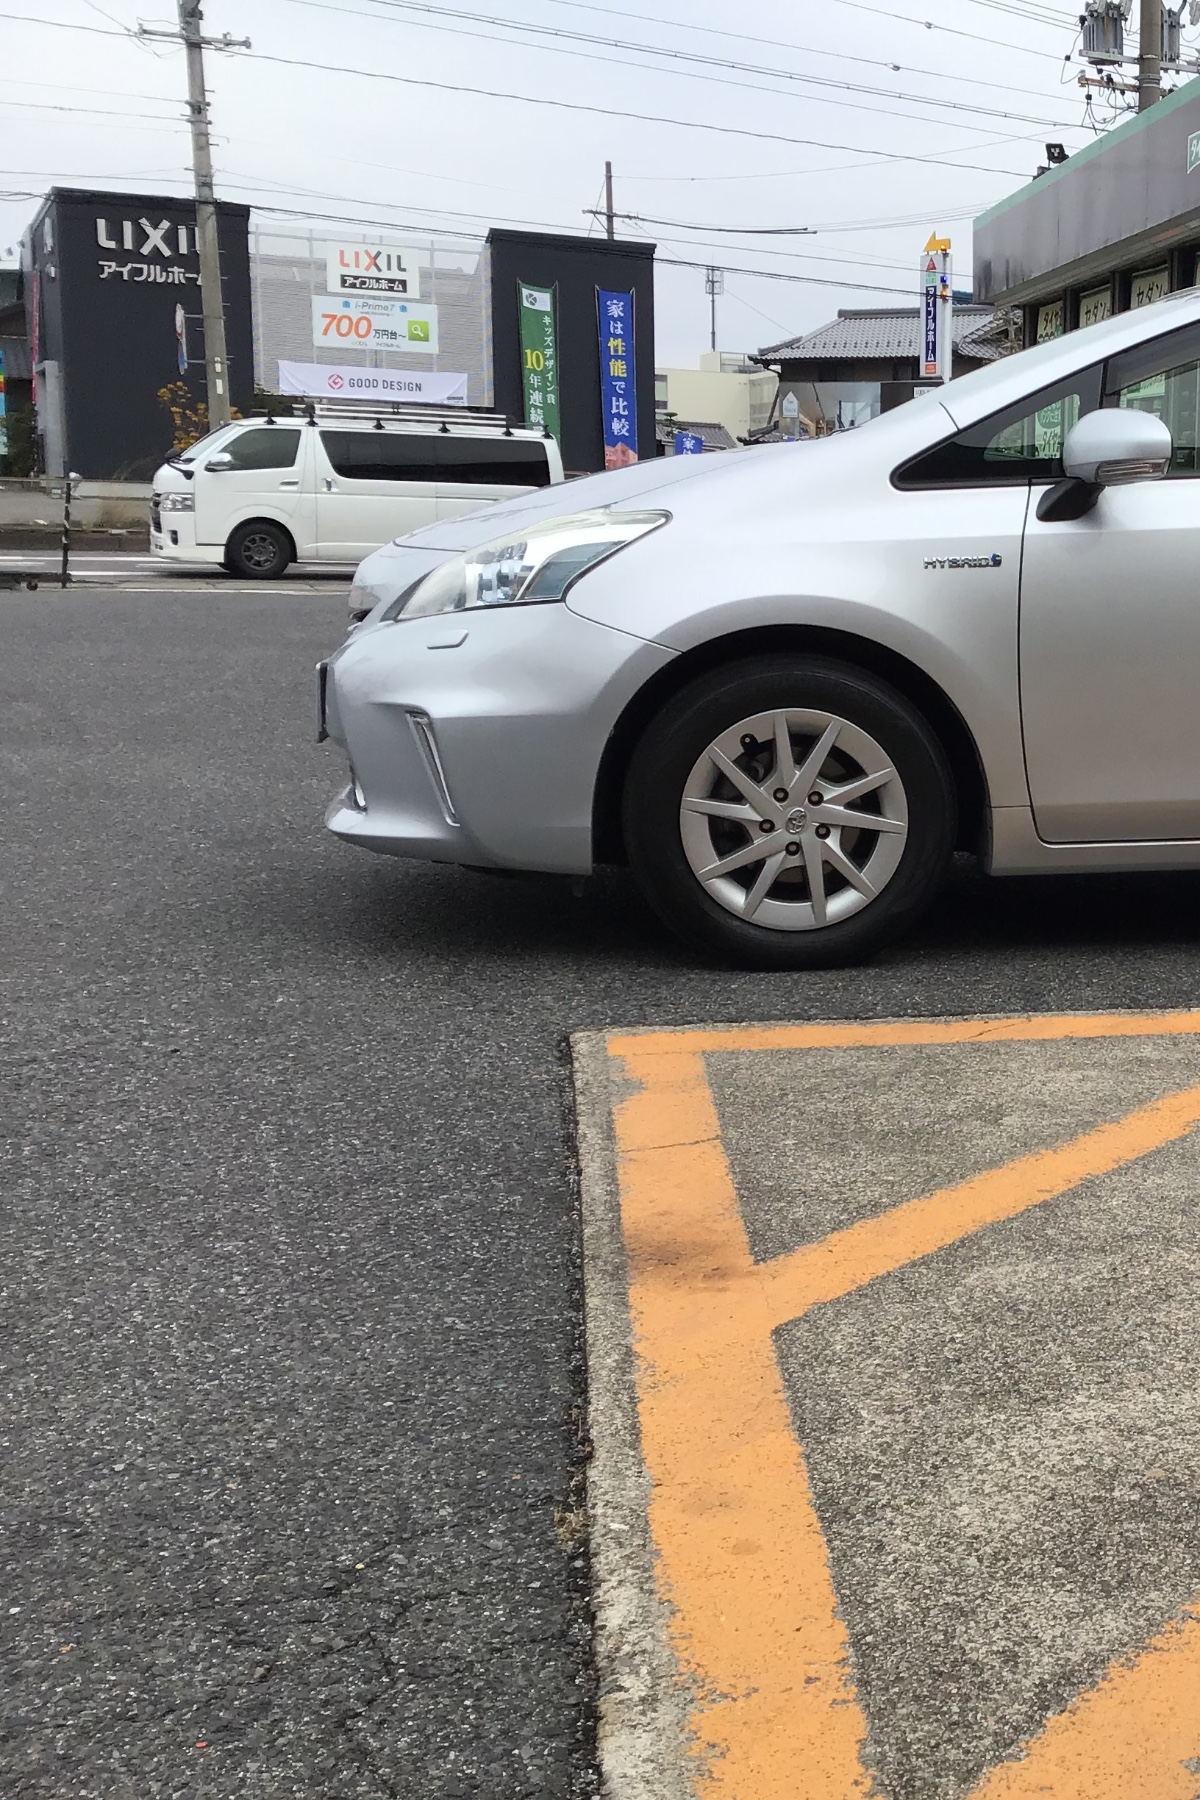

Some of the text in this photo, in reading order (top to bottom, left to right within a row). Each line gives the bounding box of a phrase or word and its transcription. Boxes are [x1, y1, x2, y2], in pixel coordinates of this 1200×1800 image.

[98, 260, 202, 285] アイフルホー
[339, 249, 407, 273] LIXIL
[344, 276, 403, 291] アイフルホーム
[542, 315, 556, 405] キッズデザイン賞
[605, 300, 630, 437] 家は性能で比較
[348, 377, 422, 393] GOOD DESIGN
[923, 556, 991, 570] HYBRID
